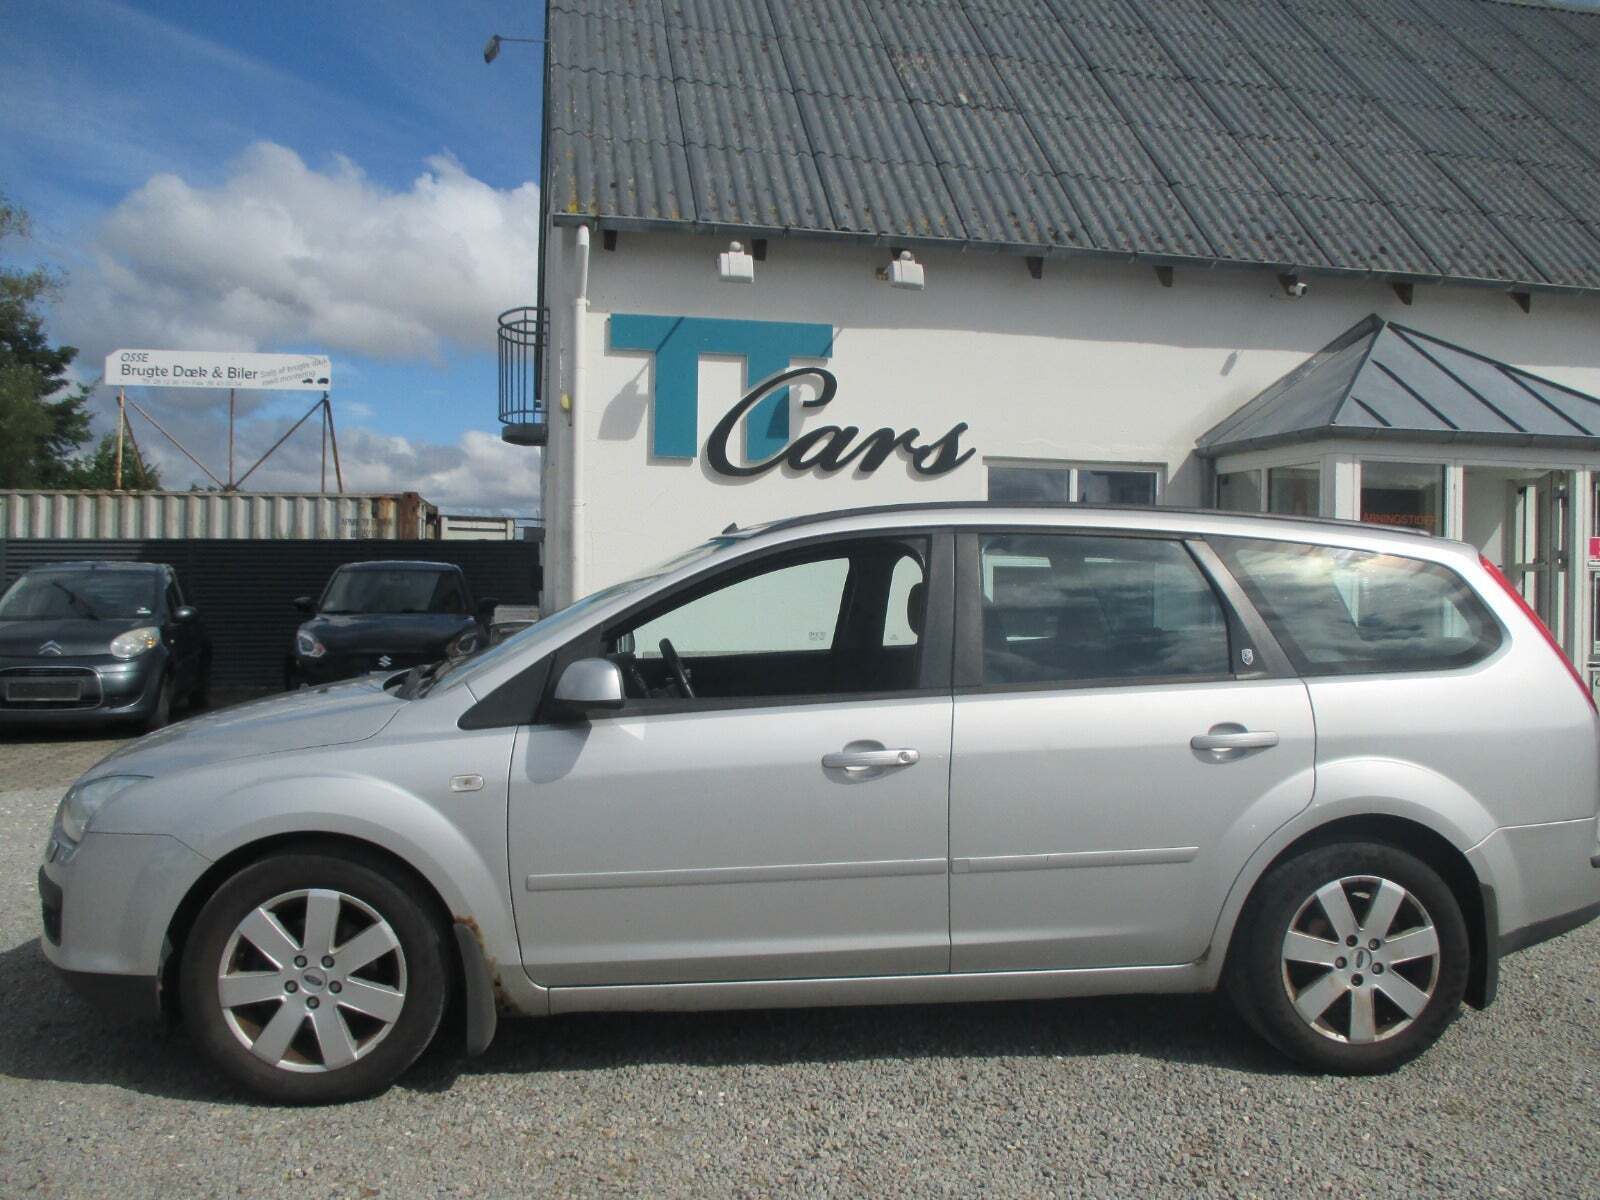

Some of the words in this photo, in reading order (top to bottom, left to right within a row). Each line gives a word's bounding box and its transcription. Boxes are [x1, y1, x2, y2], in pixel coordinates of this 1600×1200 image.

[121, 363, 168, 378] Brugte
[212, 366, 222, 378] &
[227, 367, 258, 379] Biler
[611, 313, 833, 462] TT
[707, 367, 977, 477] Cars
